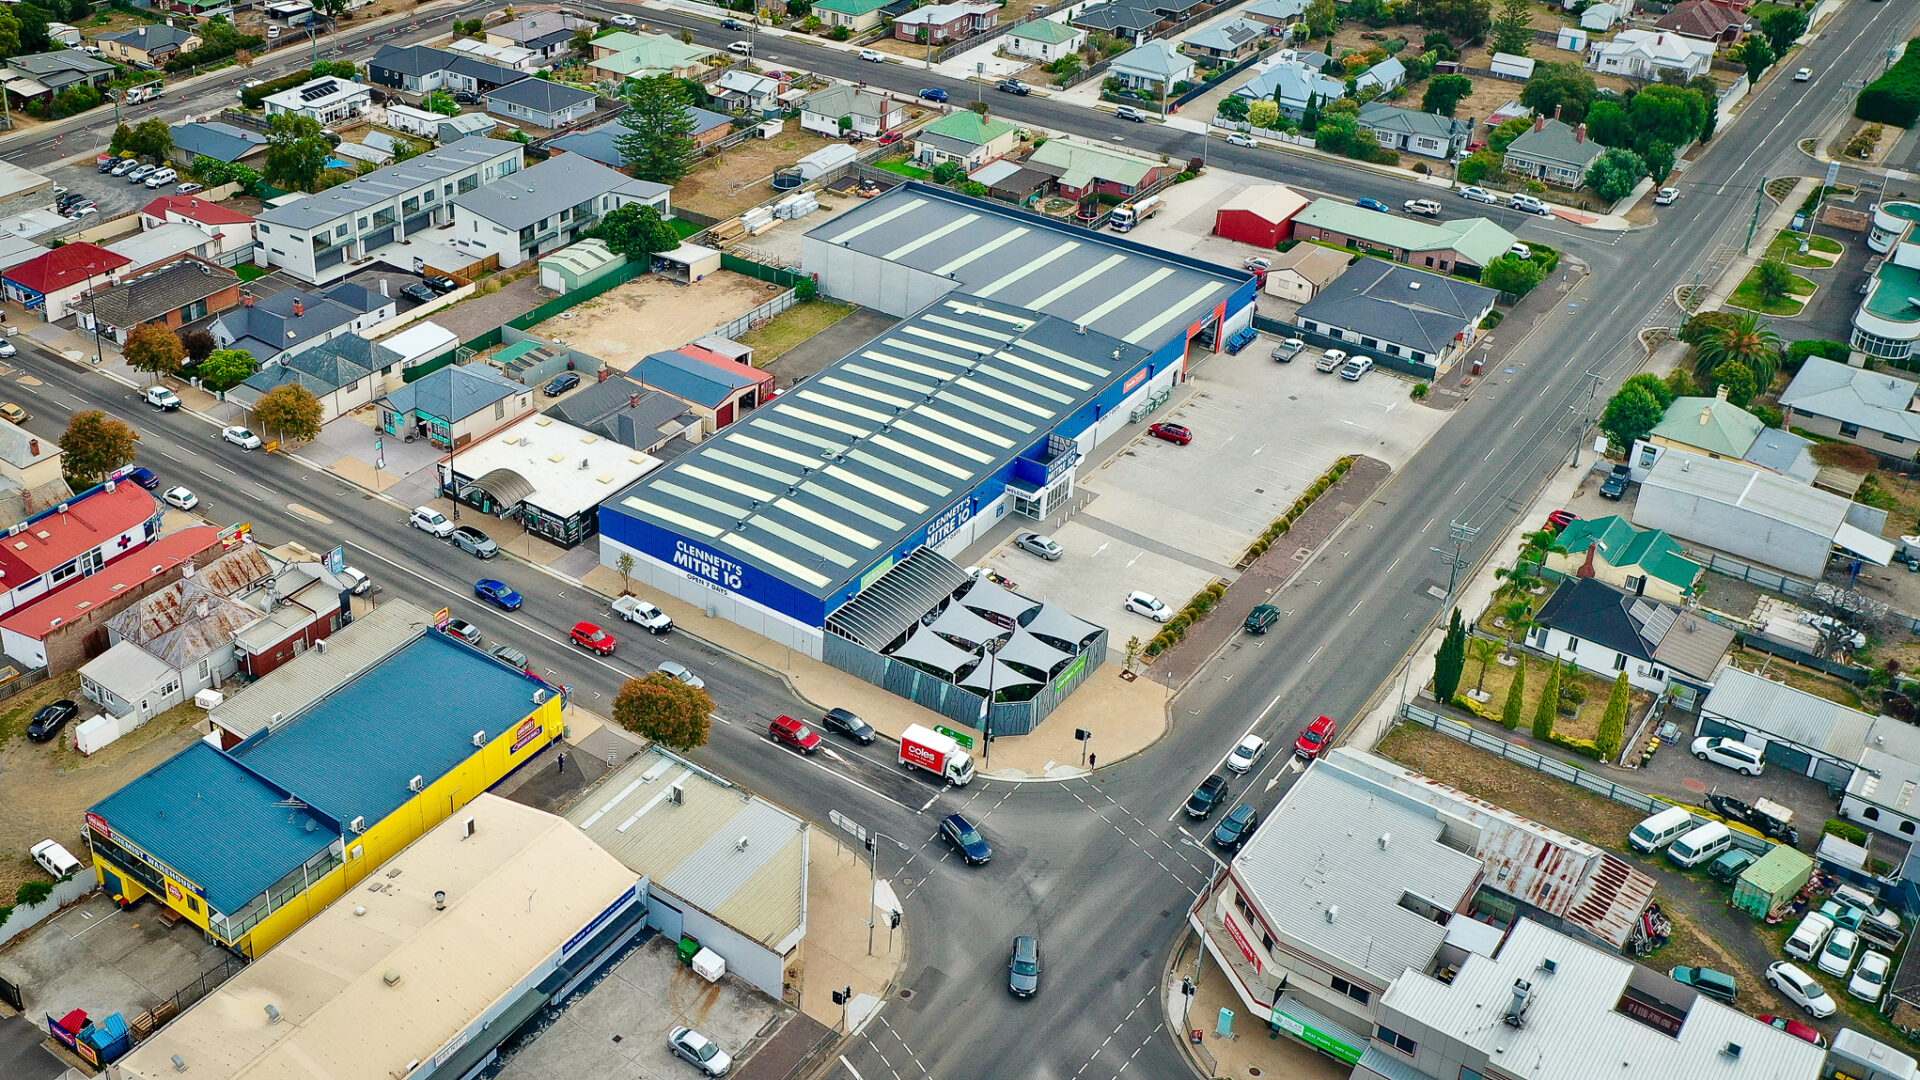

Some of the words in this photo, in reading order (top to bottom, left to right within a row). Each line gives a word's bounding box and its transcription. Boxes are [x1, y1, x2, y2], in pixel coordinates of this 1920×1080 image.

[926, 517, 955, 548] MITRE
[958, 508, 969, 525] 10
[927, 496, 970, 535] CLENNETT'S
[673, 550, 719, 581] MITRE
[723, 571, 742, 589] 10
[676, 540, 742, 576] CLENNETT'S
[687, 573, 704, 586] OPEN
[711, 584, 728, 596] DAYS
[908, 745, 935, 761] coles
[110, 832, 144, 858] CHEMIST
[146, 856, 197, 893] WAREHOUSE
